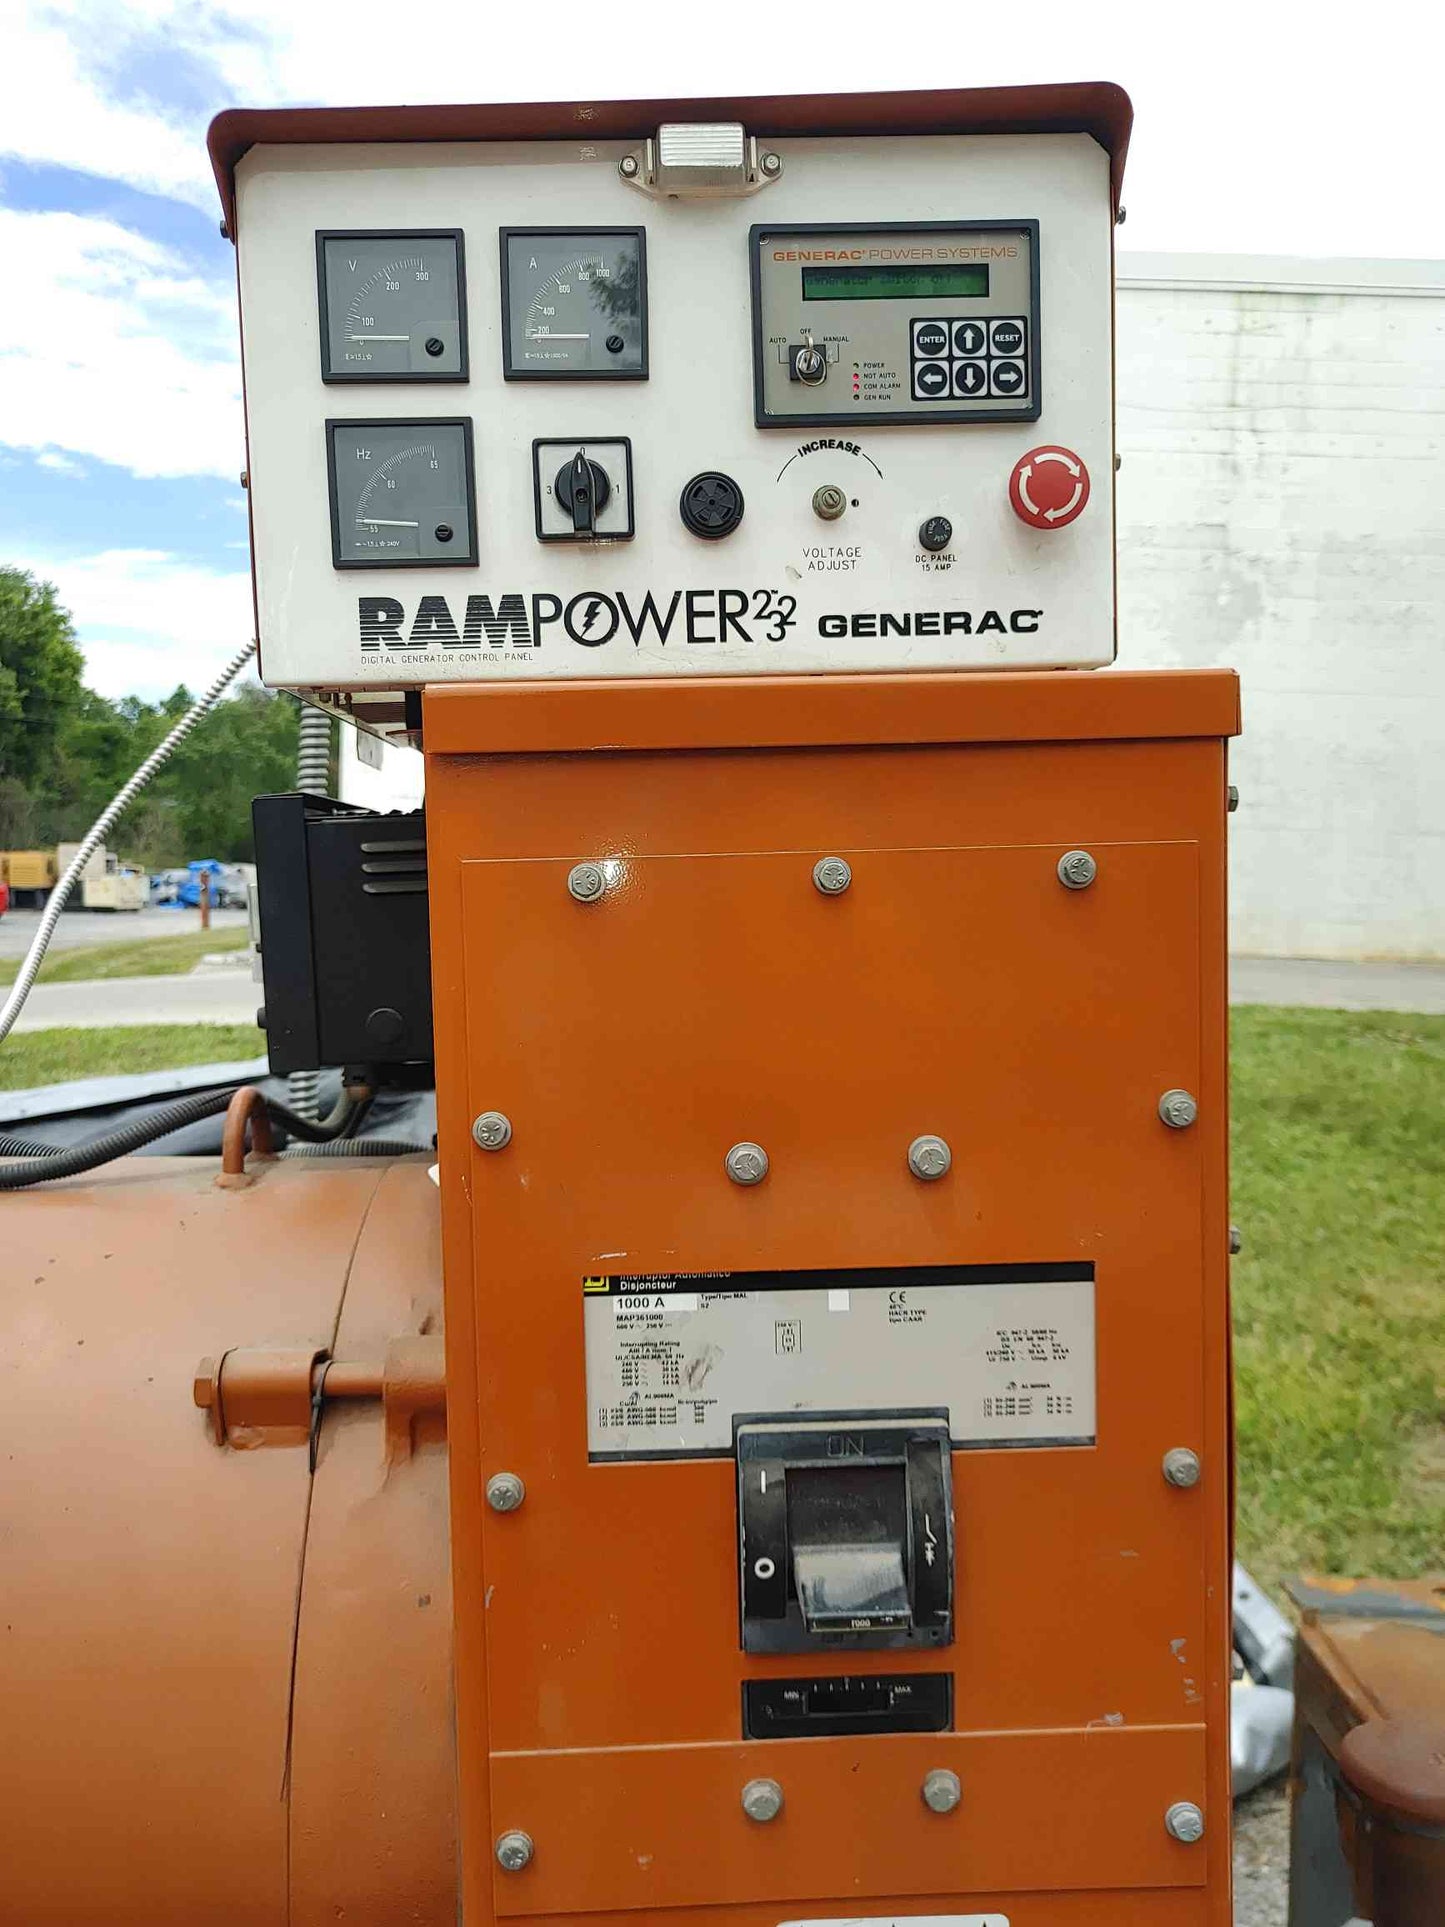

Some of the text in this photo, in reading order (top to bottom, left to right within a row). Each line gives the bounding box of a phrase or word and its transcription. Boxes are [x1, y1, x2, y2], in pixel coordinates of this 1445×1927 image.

[869, 248, 933, 261] POWER
[937, 247, 1018, 260] SYSTEMS
[348, 260, 357, 271] V
[530, 258, 537, 268] A
[416, 272, 429, 281] 300
[578, 272, 590, 280] 800
[596, 269, 610, 277] 1000
[386, 282, 399, 291] 200
[543, 307, 555, 316] 400
[362, 317, 374, 326] 100
[538, 326, 550, 334] 200
[823, 335, 850, 343] MANUAL
[919, 335, 945, 344] ENTER
[994, 334, 1019, 343] RESET
[879, 382, 901, 390] ALARM
[797, 438, 862, 457] INCREASE
[356, 448, 372, 460] Hz
[430, 460, 439, 469] 65
[387, 480, 396, 489] 60
[546, 485, 552, 495] 3
[802, 547, 862, 559] VOLTAGE
[915, 554, 957, 563] DC PANEL
[808, 559, 858, 571] ADJUST
[922, 563, 952, 571] 15 AMP
[818, 610, 1040, 639] GENERAC
[361, 652, 533, 665] DIGITAL GENERATOR CONTROL PANEL
[620, 1281, 677, 1293] Disjoncteur
[617, 1297, 665, 1309] 1000 A
[827, 1434, 864, 1457] ON
[894, 1685, 912, 1694] MAX
[783, 1690, 800, 1700] MIN
